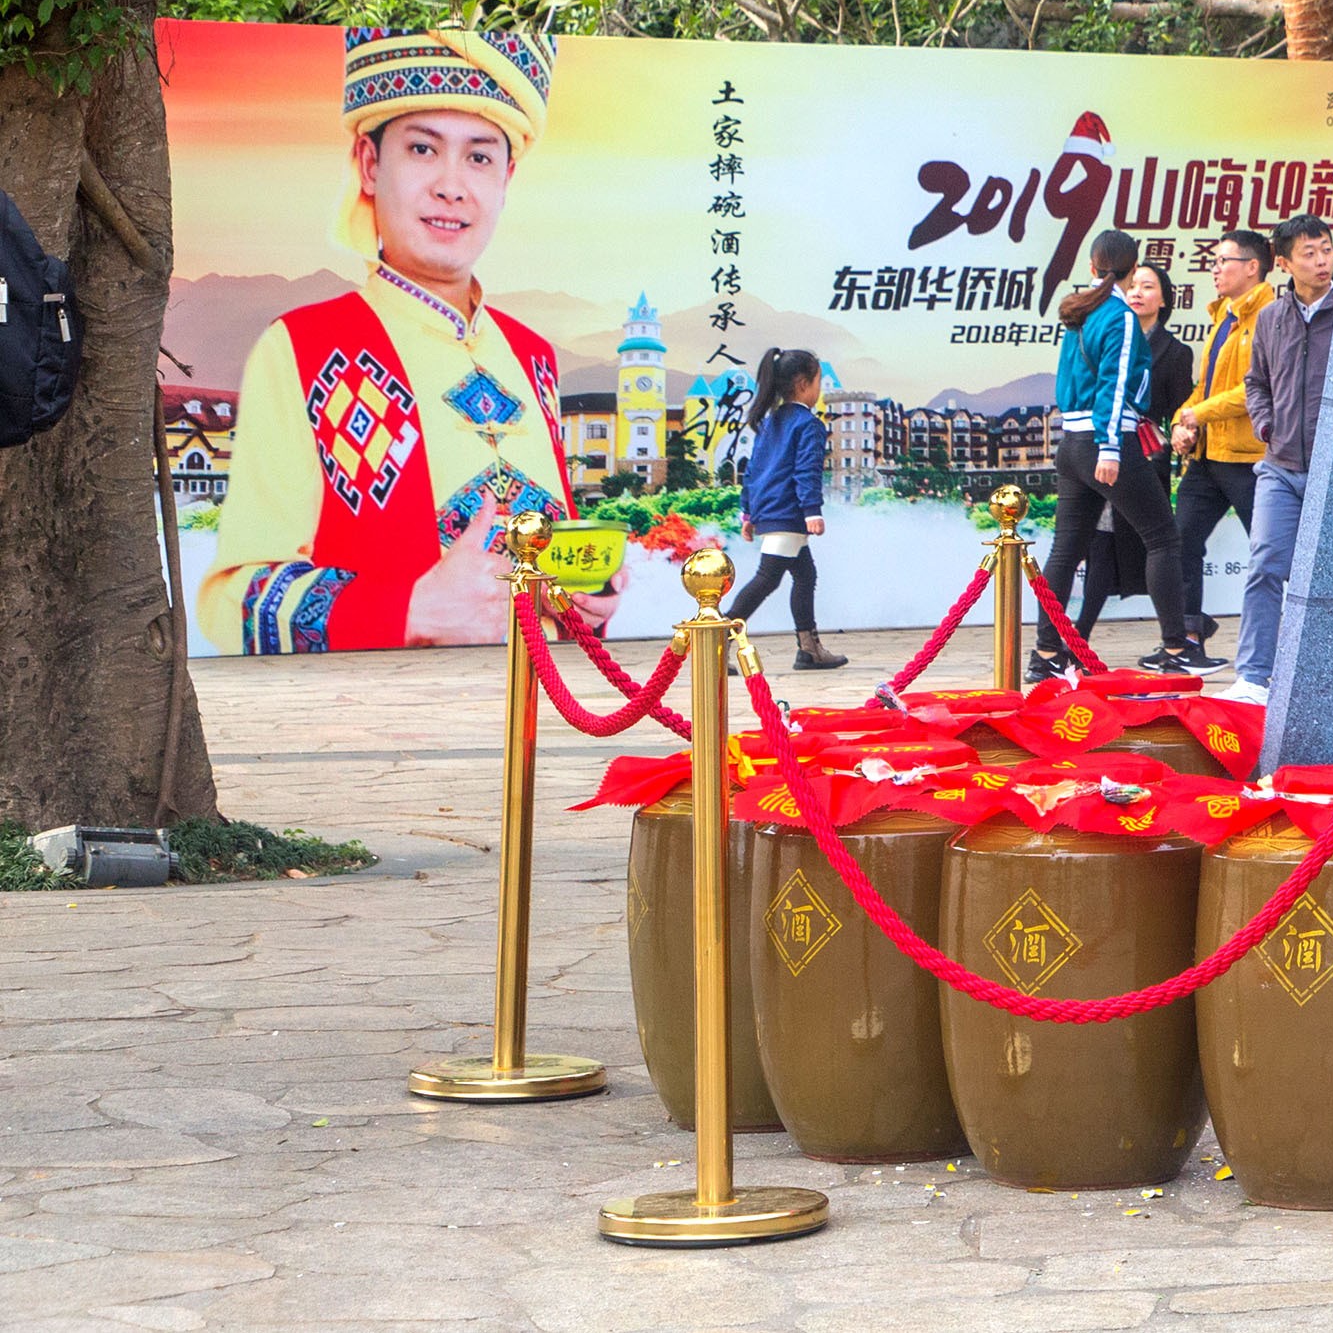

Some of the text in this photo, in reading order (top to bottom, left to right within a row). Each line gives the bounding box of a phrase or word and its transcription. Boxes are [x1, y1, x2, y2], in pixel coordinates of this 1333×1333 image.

[705, 79, 747, 366] 土家摔碗酒传承人
[908, 150, 1113, 318] 2019
[828, 264, 1039, 314] 东部华侨城
[780, 898, 814, 947] 酒
[1008, 918, 1050, 966] 酒
[1282, 924, 1326, 972] 酒
